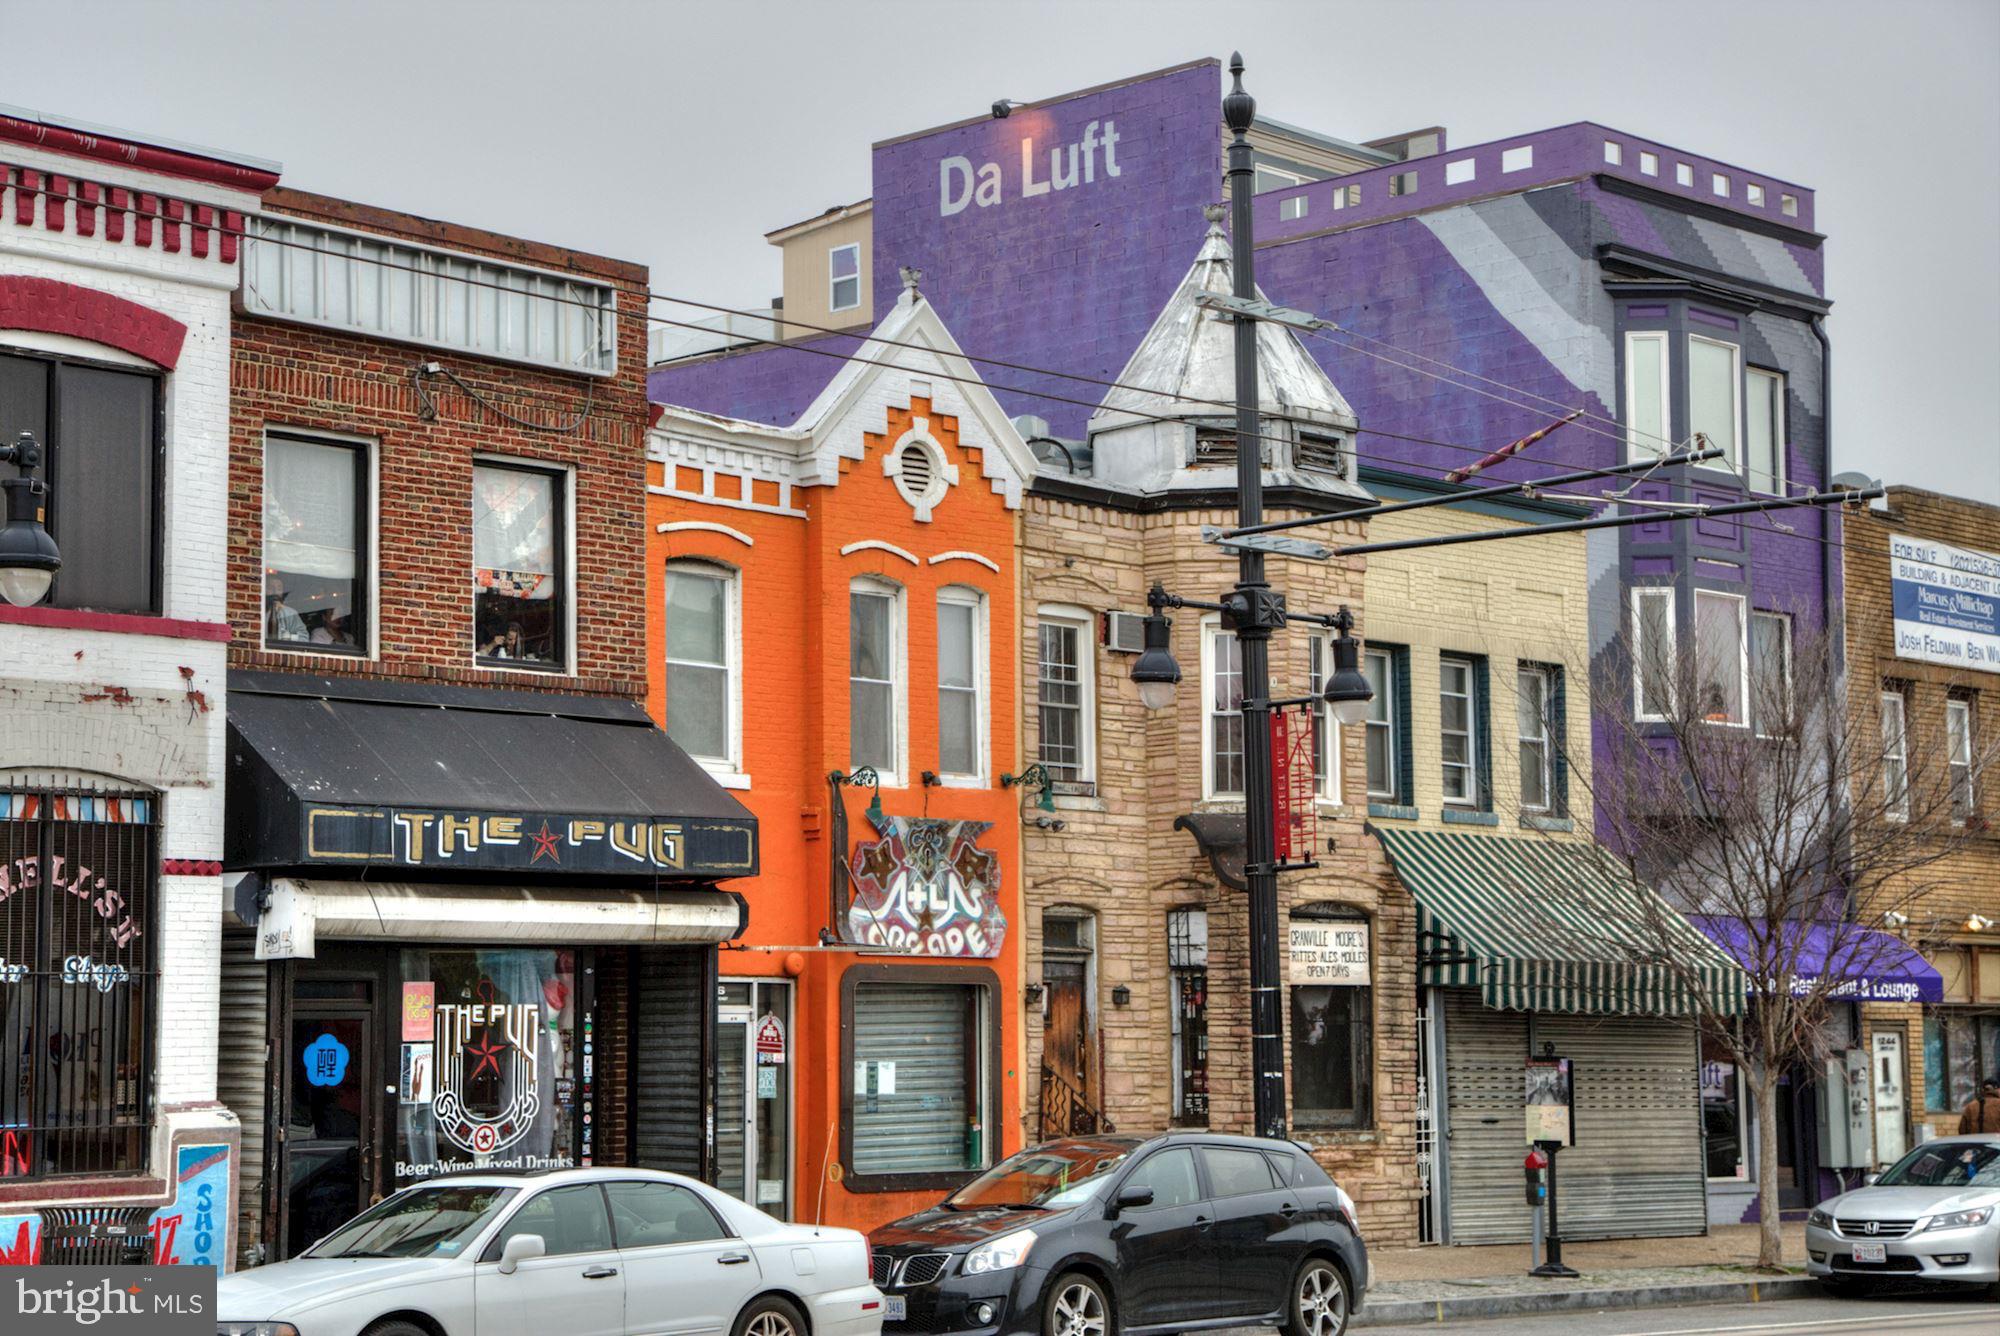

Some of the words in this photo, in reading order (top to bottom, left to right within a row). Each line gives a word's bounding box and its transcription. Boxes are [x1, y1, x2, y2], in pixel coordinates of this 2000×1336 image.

[941, 155, 1002, 217] Da
[1022, 120, 1121, 198] Luft
[1894, 543, 1913, 561] FOR
[1916, 547, 1937, 563] SALE
[1900, 565, 1937, 582] BUILDING
[1941, 572, 1948, 585] &
[1950, 574, 1990, 593] ADJACENT
[1919, 586, 1948, 606] Marcus
[1956, 592, 1994, 618] Millichap
[1899, 632, 1922, 651] JOSH
[1924, 635, 1962, 658] FELDMAN
[1967, 642, 1984, 661] BEN
[396, 813, 525, 864] THE
[568, 819, 684, 869] PUG
[1291, 930, 1328, 947] GRANVILLE
[1335, 931, 1364, 947] MOORE'S
[1320, 951, 1338, 963] ALES
[1341, 951, 1368, 963] MOULES
[1307, 965, 1325, 978] OPEN
[1332, 965, 1350, 978] DAYS
[1860, 977, 1870, 997] &
[1873, 980, 1920, 1003] Lounge
[526, 1154, 573, 1170] Drinks
